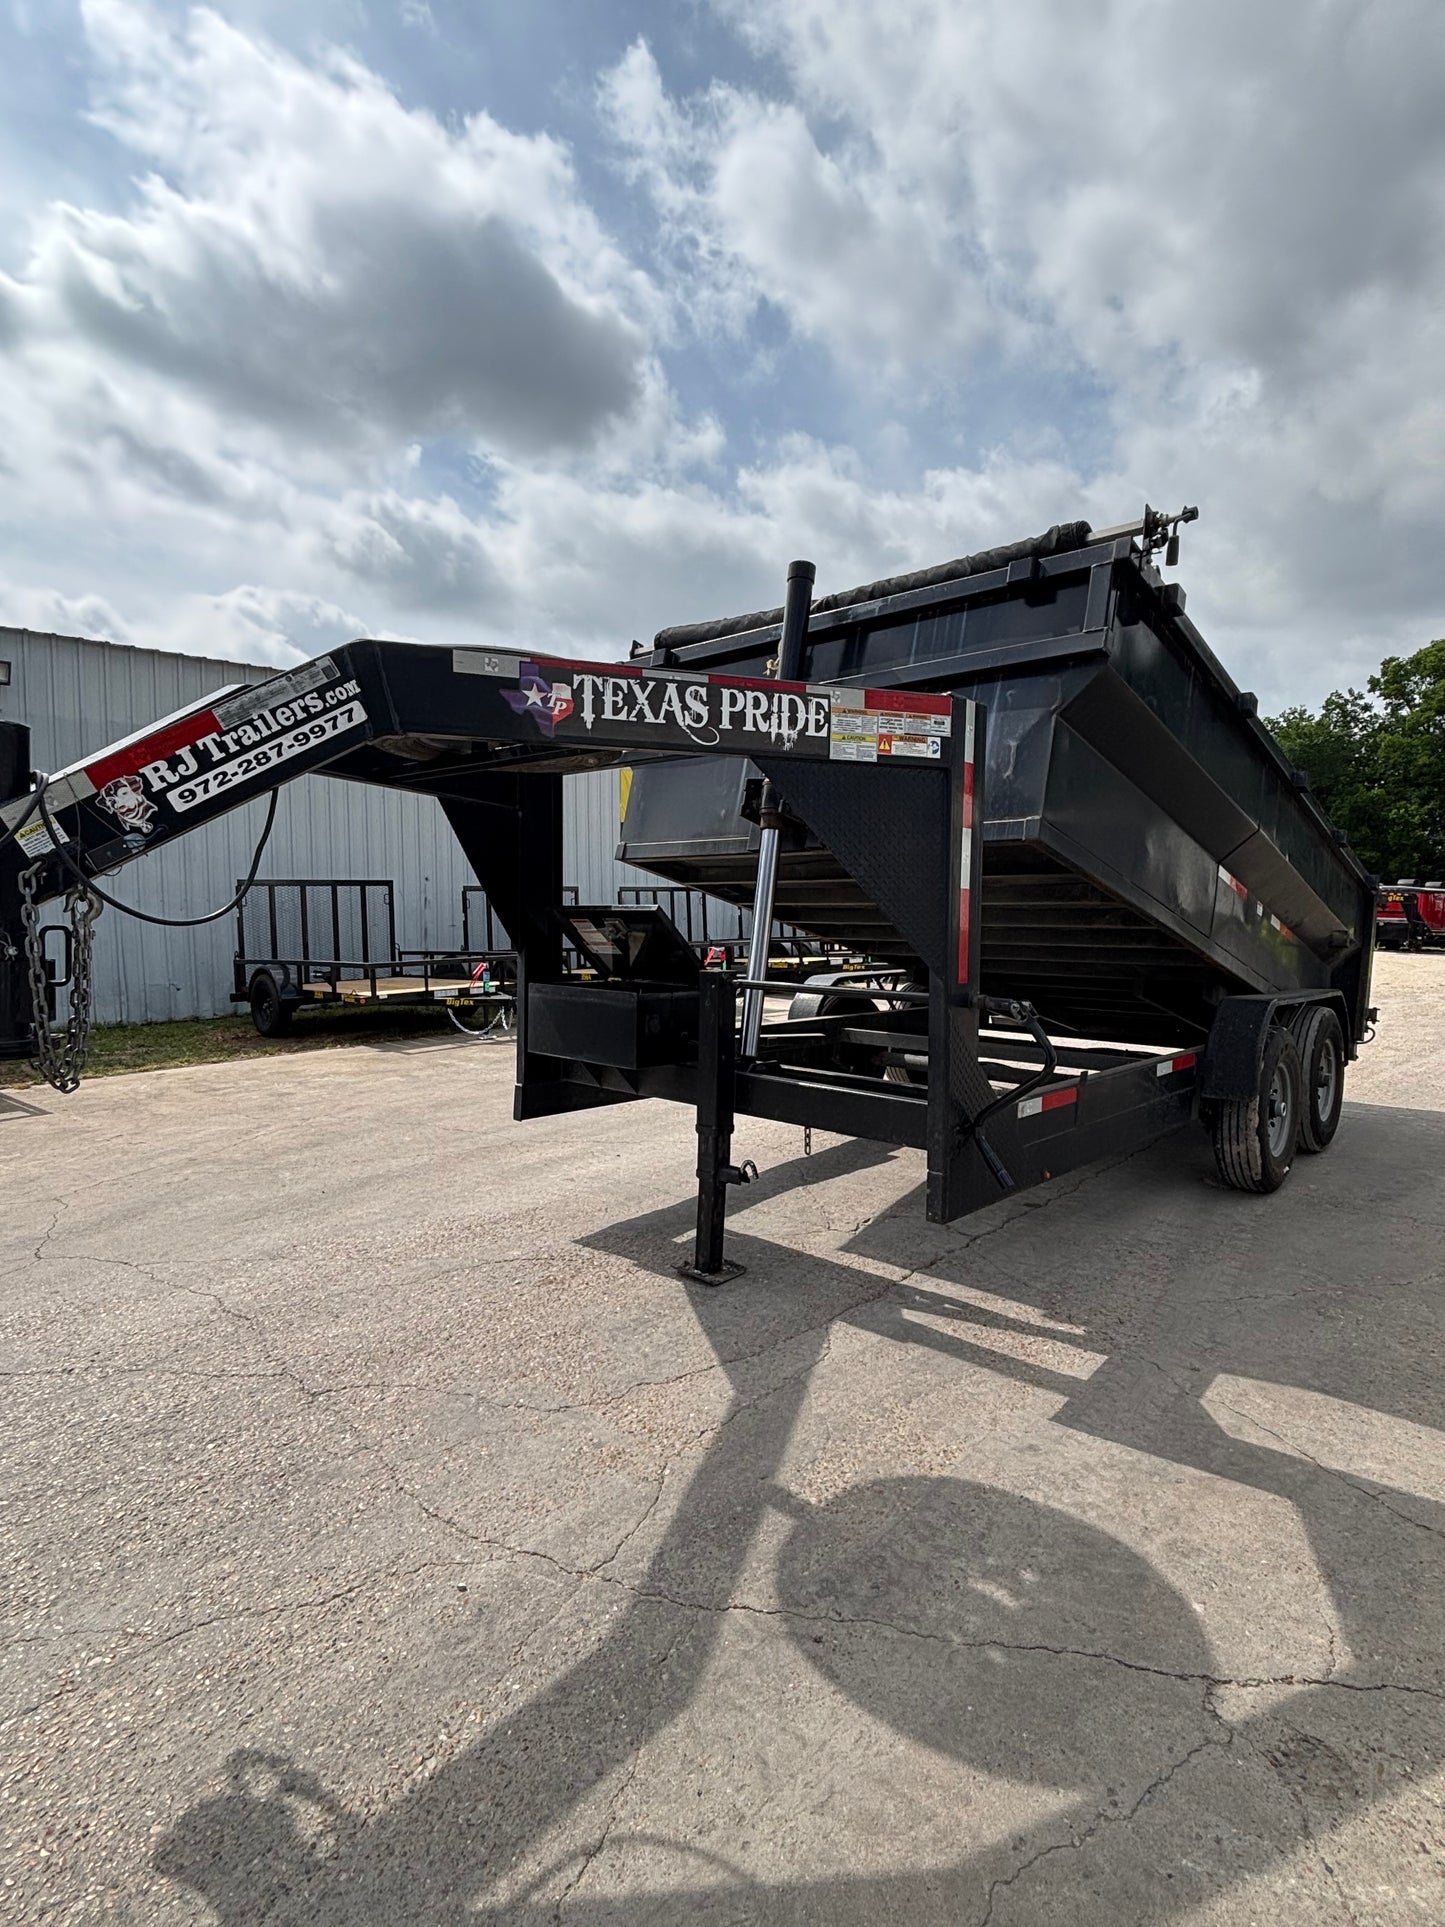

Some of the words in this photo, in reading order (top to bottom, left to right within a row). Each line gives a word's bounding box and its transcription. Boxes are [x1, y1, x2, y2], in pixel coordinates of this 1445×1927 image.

[139, 745, 199, 792] RJ
[196, 679, 362, 762] Trailers.com
[547, 692, 568, 715] TP
[573, 674, 719, 745] TEXAS
[719, 687, 829, 747] PRIDE
[177, 705, 356, 804] 972-287-9977
